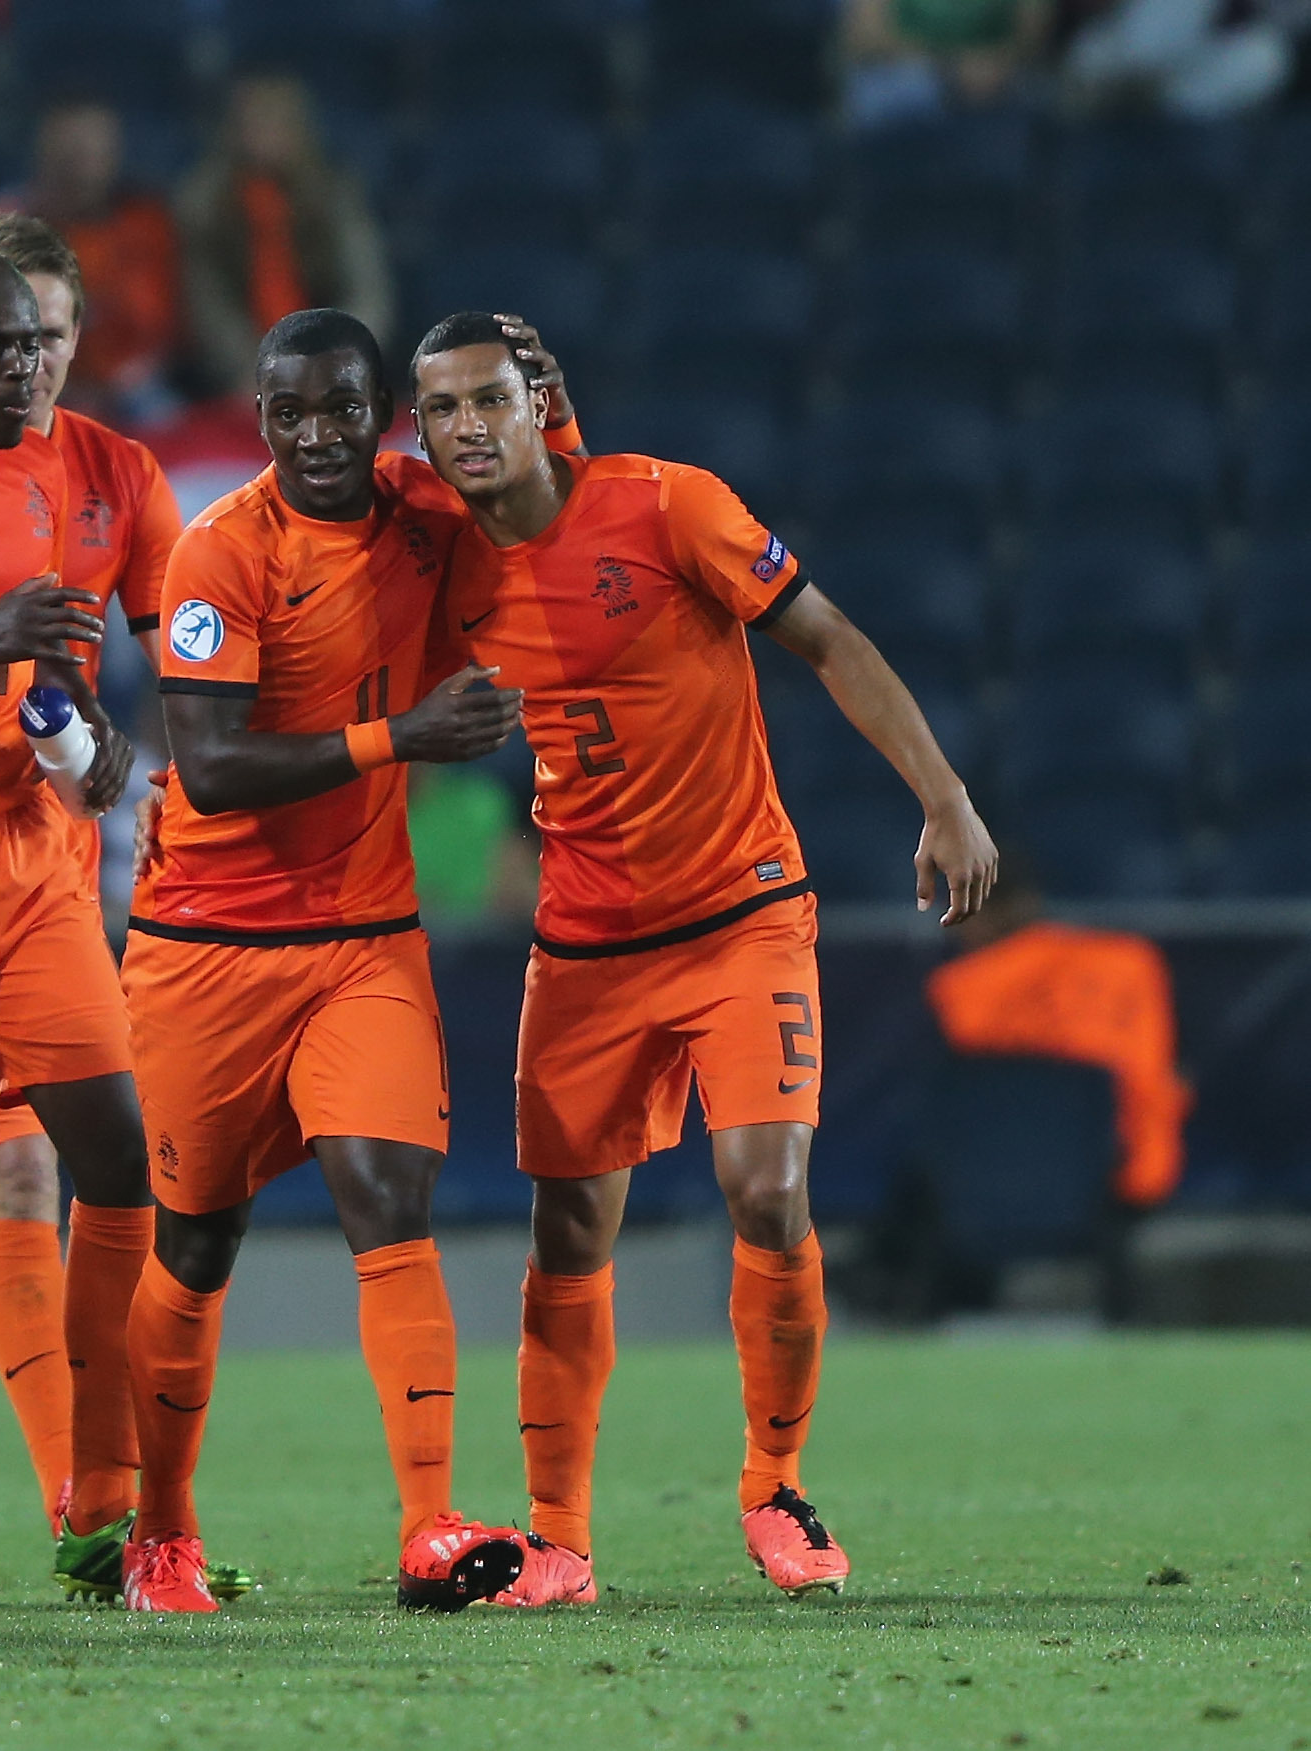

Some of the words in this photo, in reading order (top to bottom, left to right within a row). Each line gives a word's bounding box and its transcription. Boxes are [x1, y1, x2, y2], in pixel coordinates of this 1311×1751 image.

[604, 599, 639, 620] KNVB
[564, 697, 627, 778] 2
[771, 992, 817, 1069] 2
